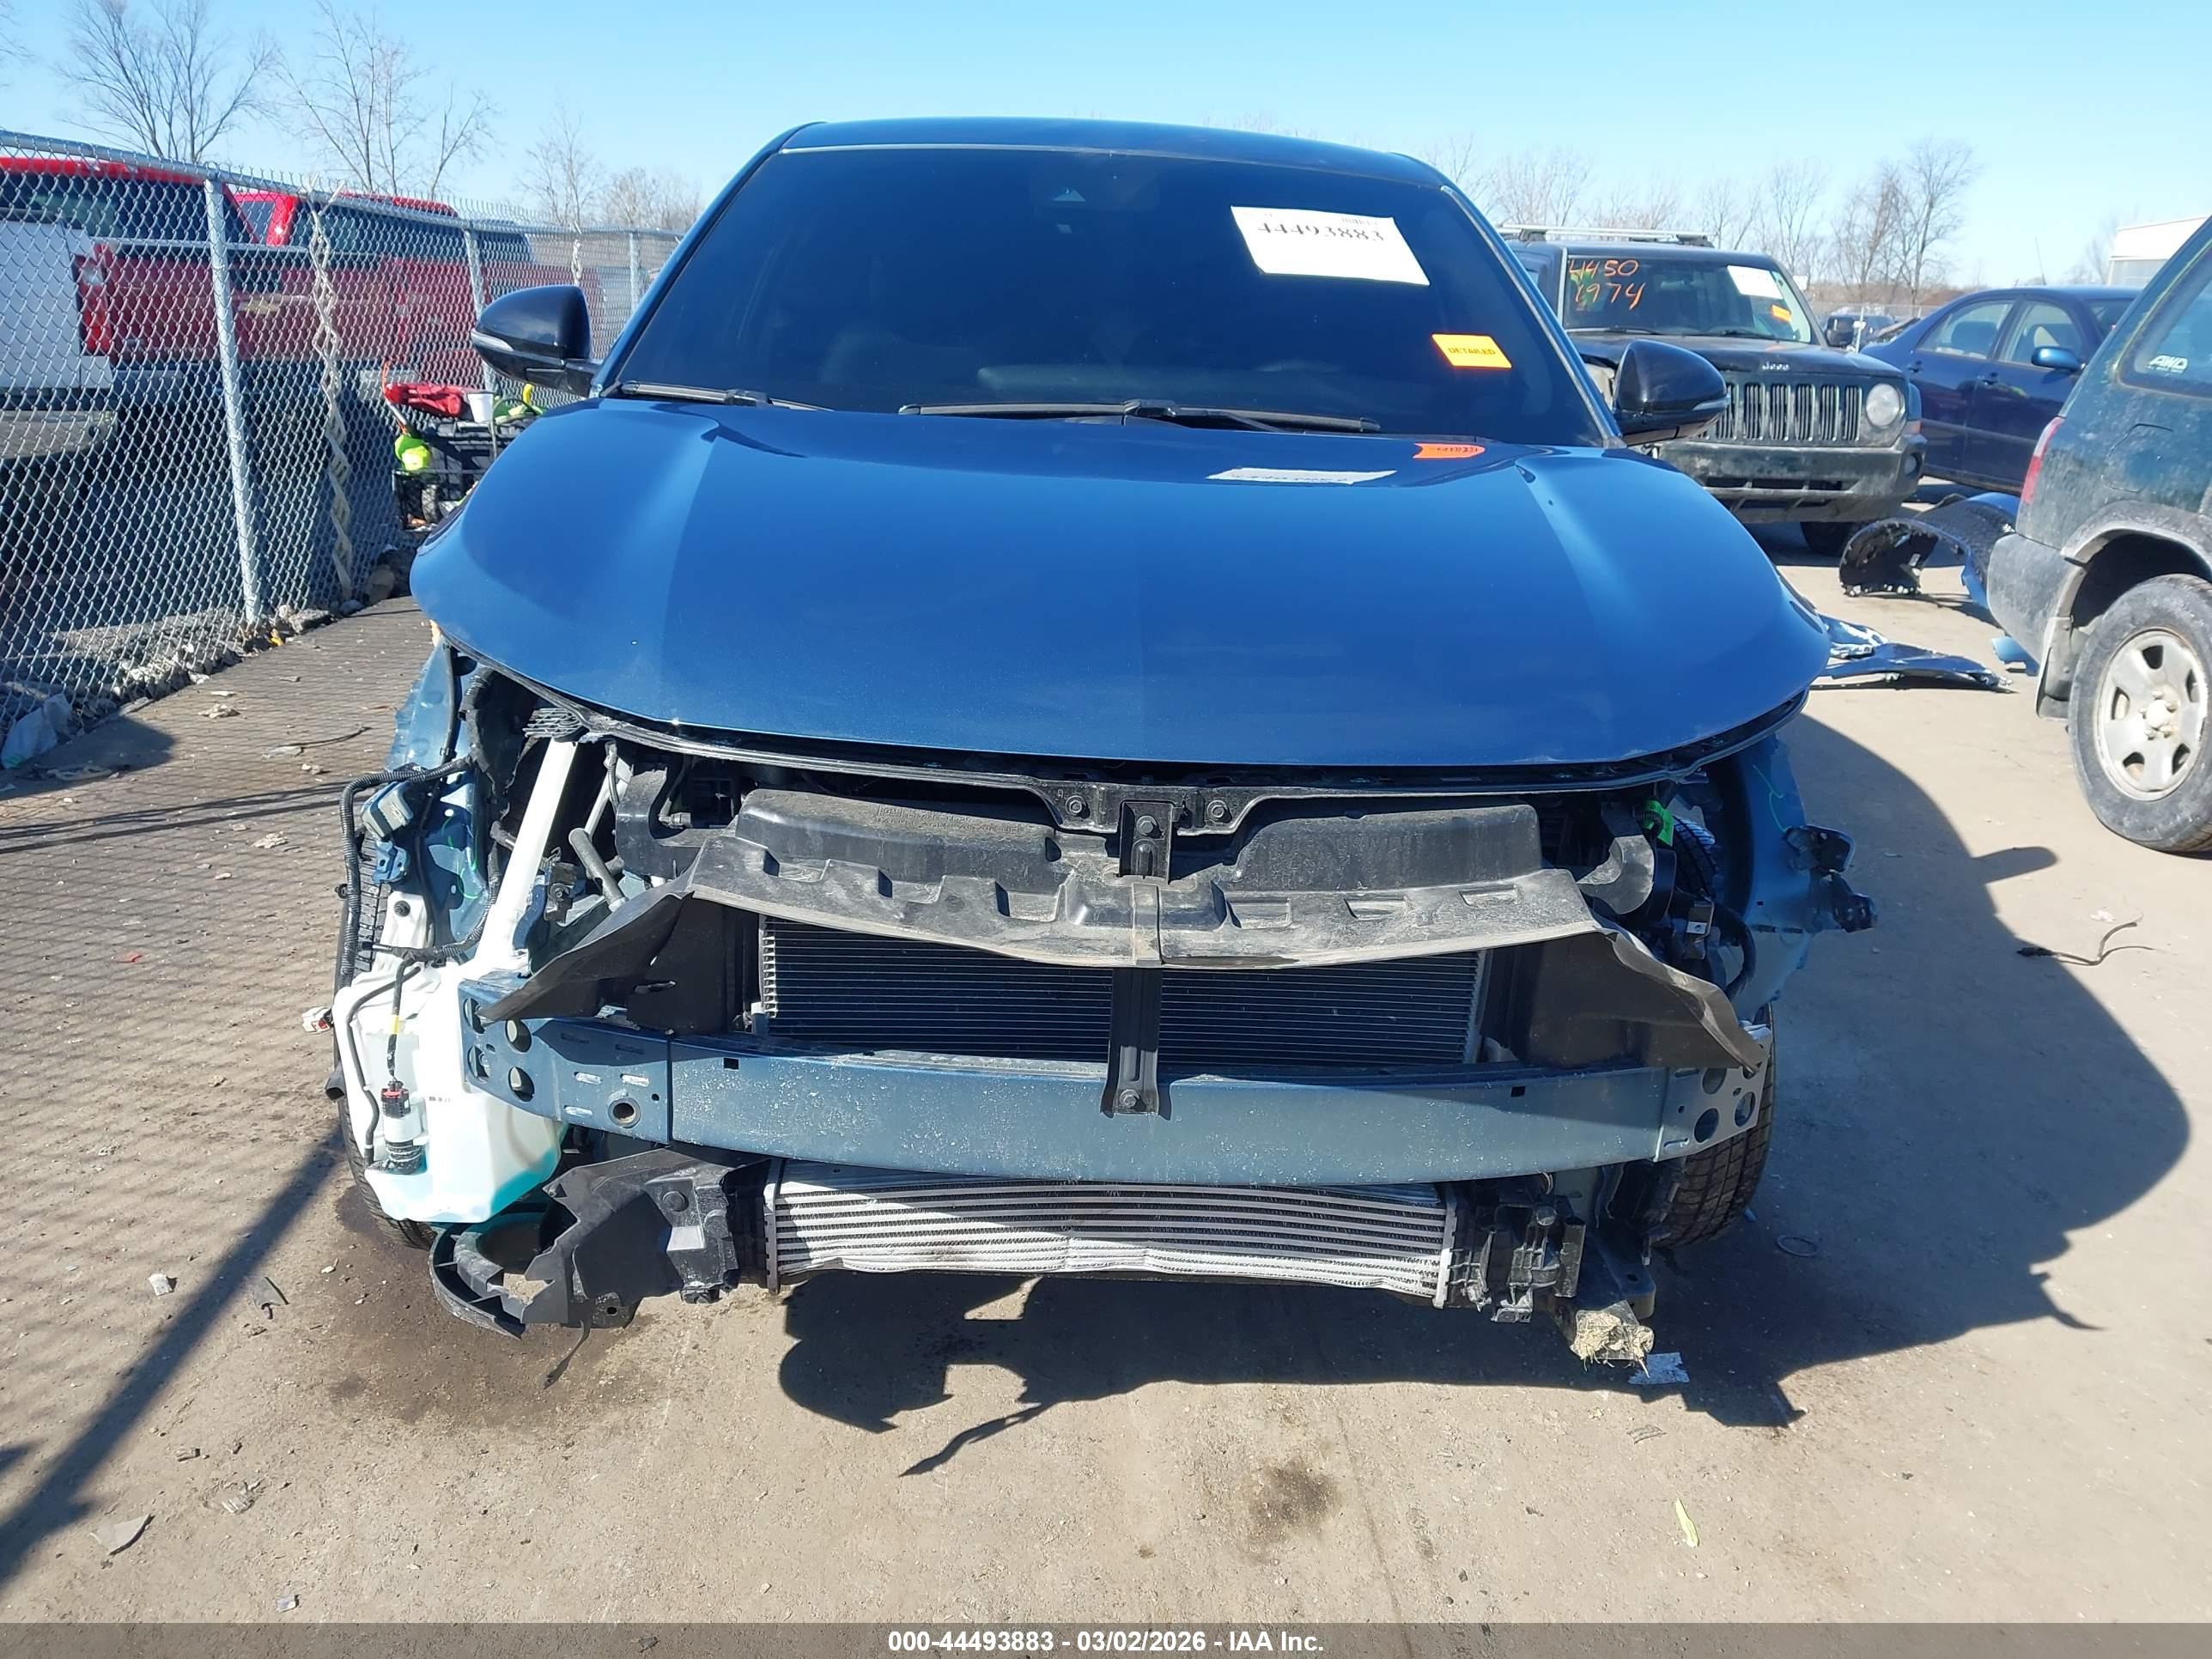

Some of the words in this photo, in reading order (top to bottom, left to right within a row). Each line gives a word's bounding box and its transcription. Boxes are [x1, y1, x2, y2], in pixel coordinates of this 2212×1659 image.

[1257, 222, 1384, 241] 44493883
[1575, 282, 1646, 311] 1974
[1448, 347, 1496, 356] DETAILED
[2148, 354, 2189, 370] AWD
